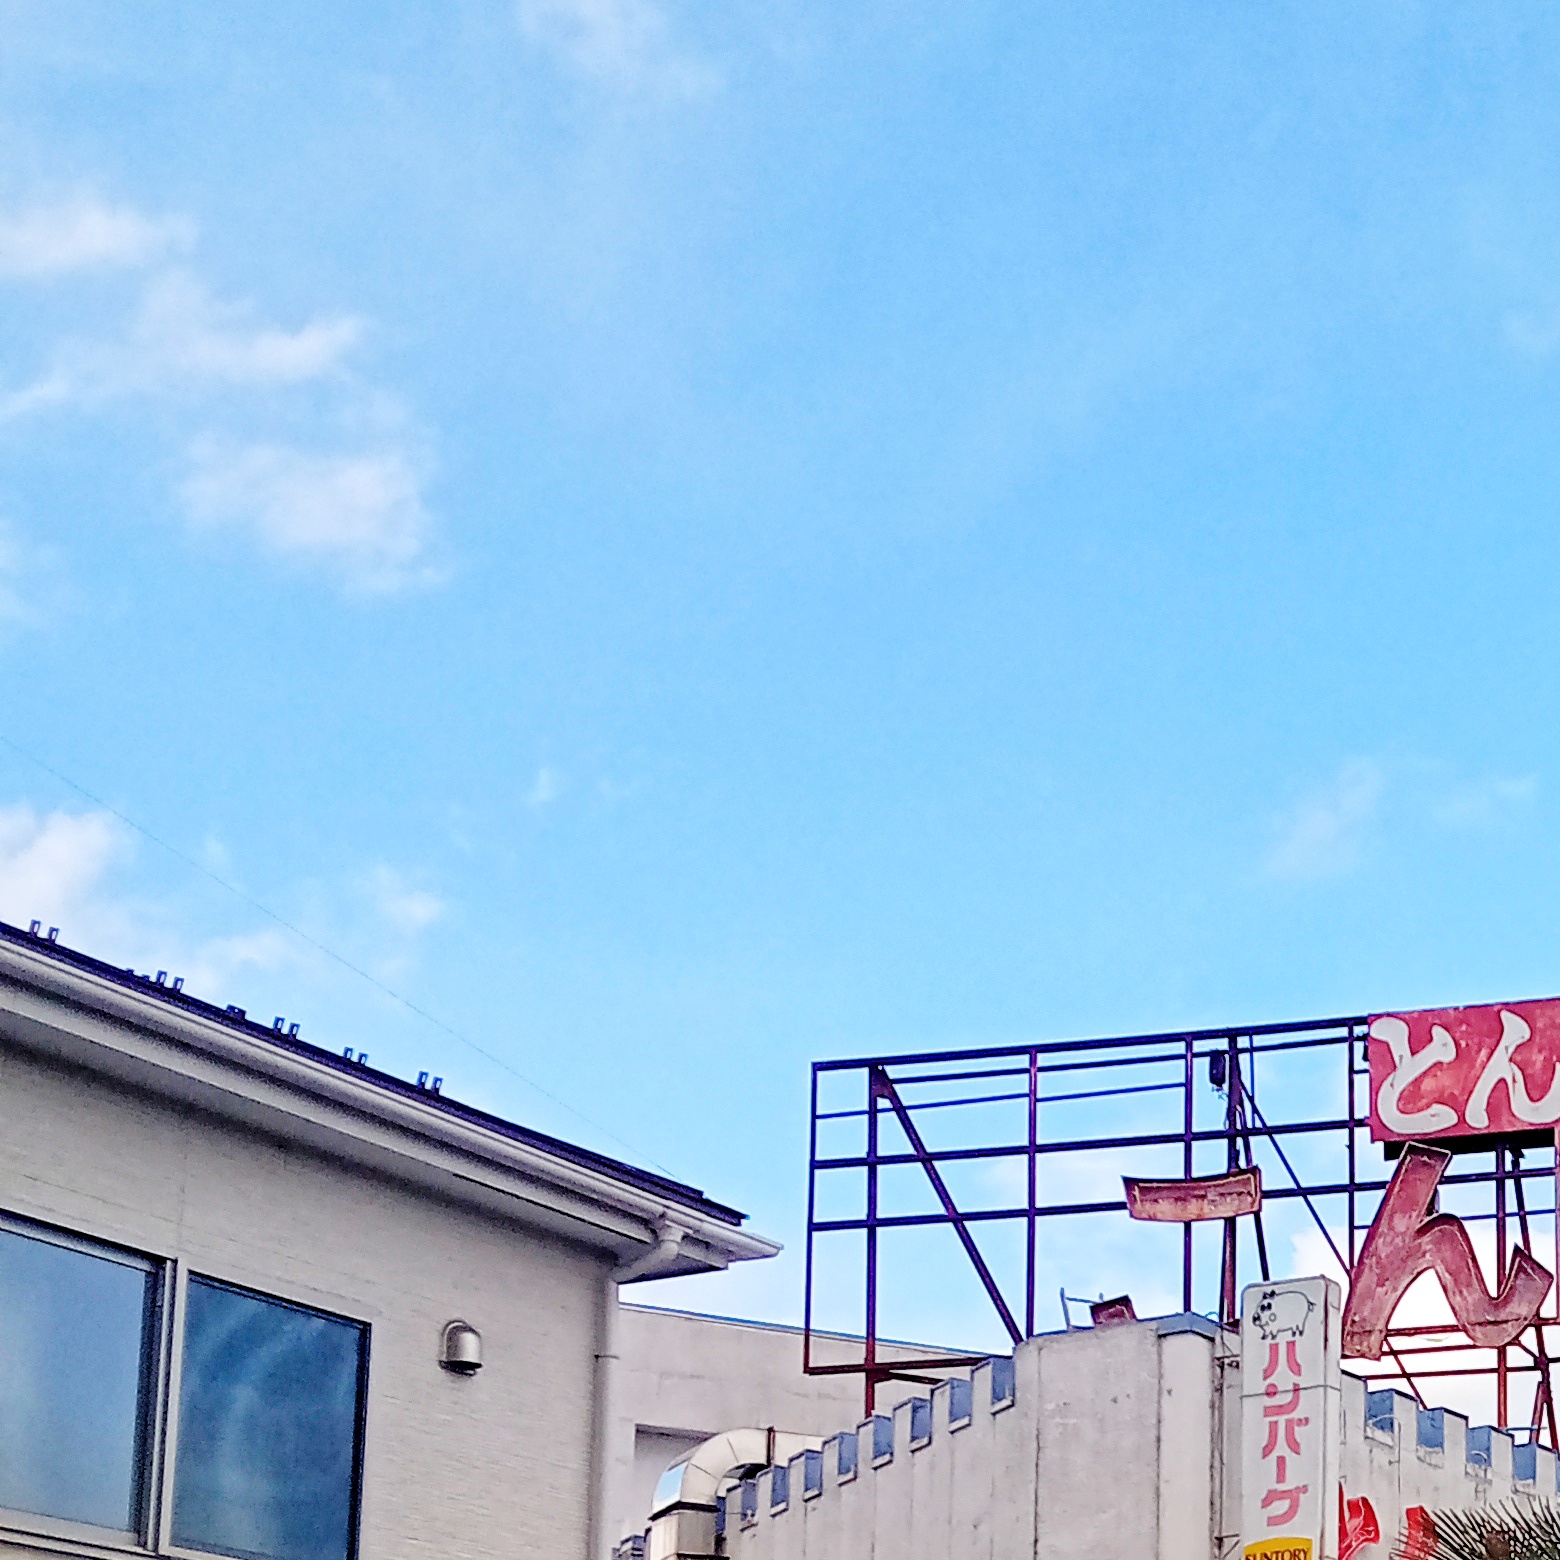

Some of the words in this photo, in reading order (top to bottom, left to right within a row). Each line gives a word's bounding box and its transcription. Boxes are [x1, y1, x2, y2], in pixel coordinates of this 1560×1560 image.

[1261, 1340, 1309, 1528] ハンバーグ
